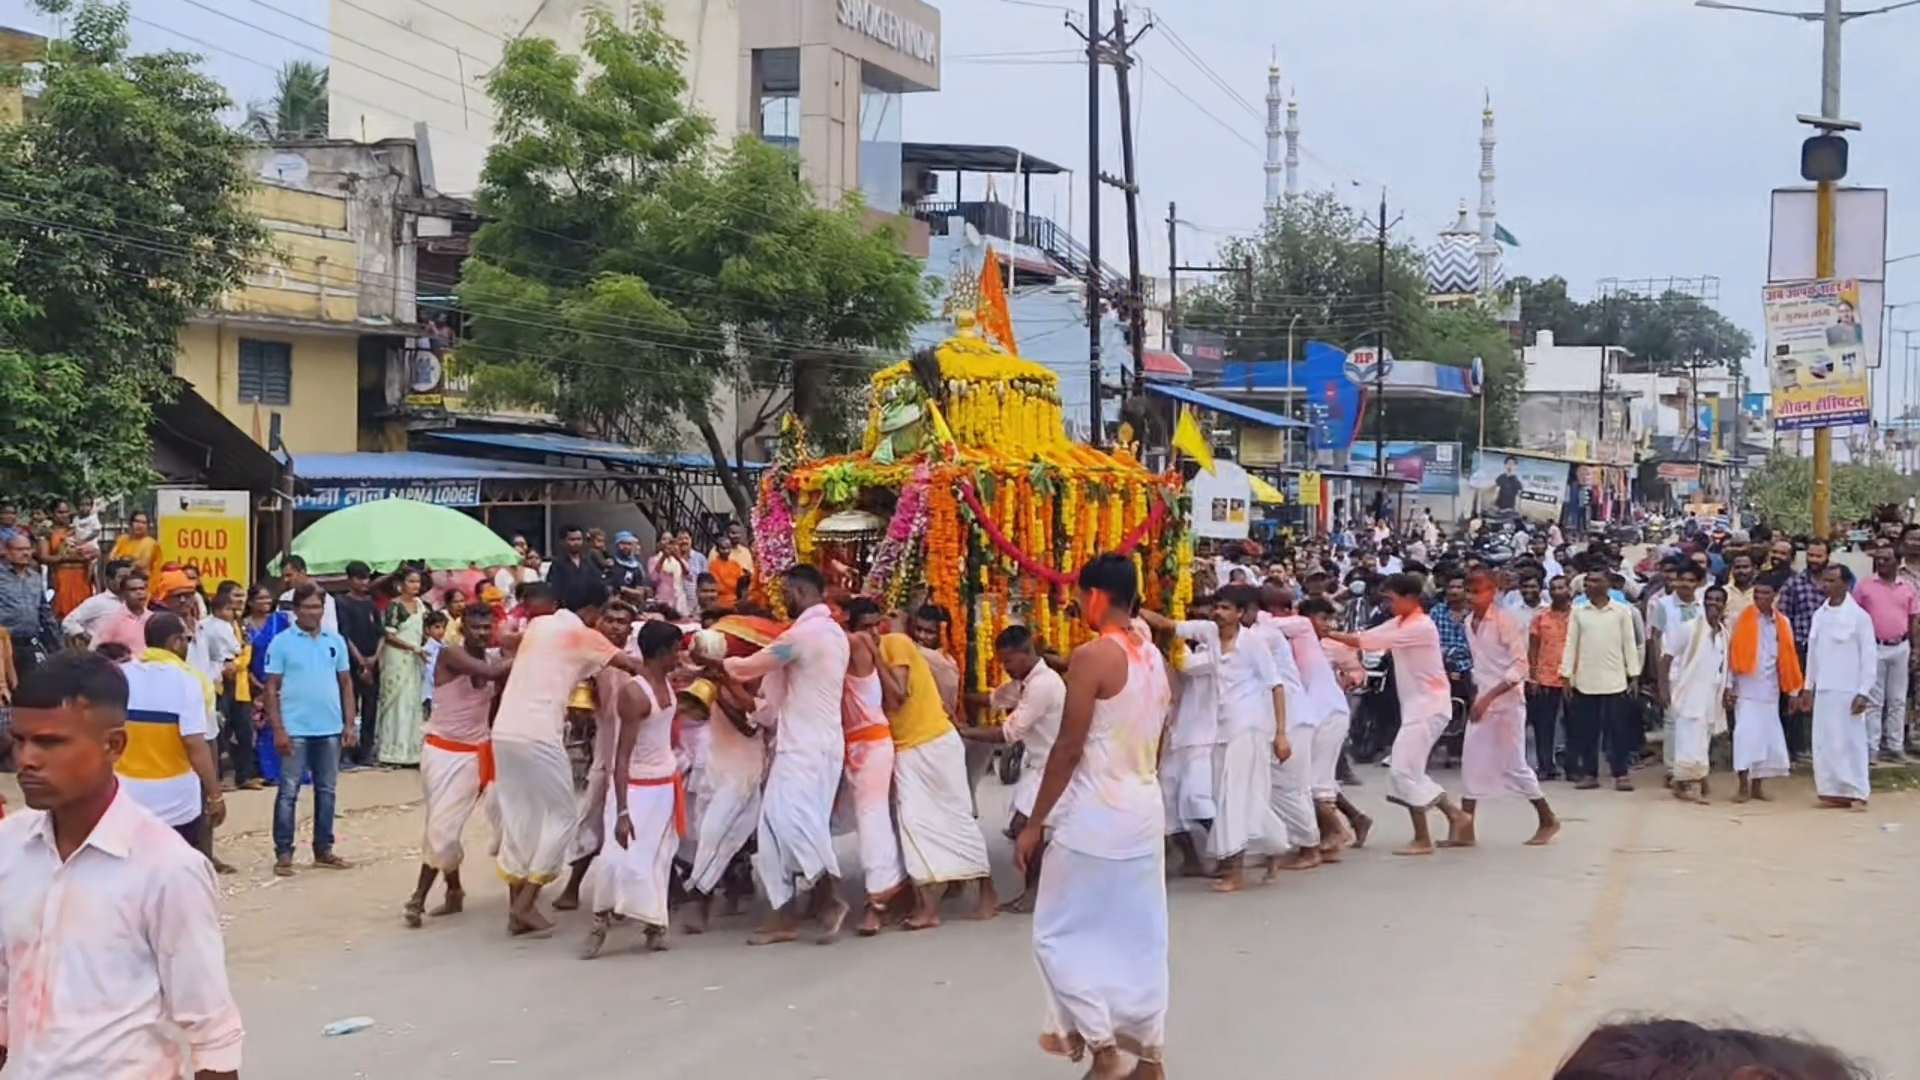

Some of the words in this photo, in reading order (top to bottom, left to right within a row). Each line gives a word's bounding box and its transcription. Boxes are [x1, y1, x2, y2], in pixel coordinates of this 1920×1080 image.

[1353, 352, 1374, 364] HP
[1778, 400, 1811, 415] जीवन
[434, 486, 476, 503] LODGE
[177, 528, 228, 550] GOLD
